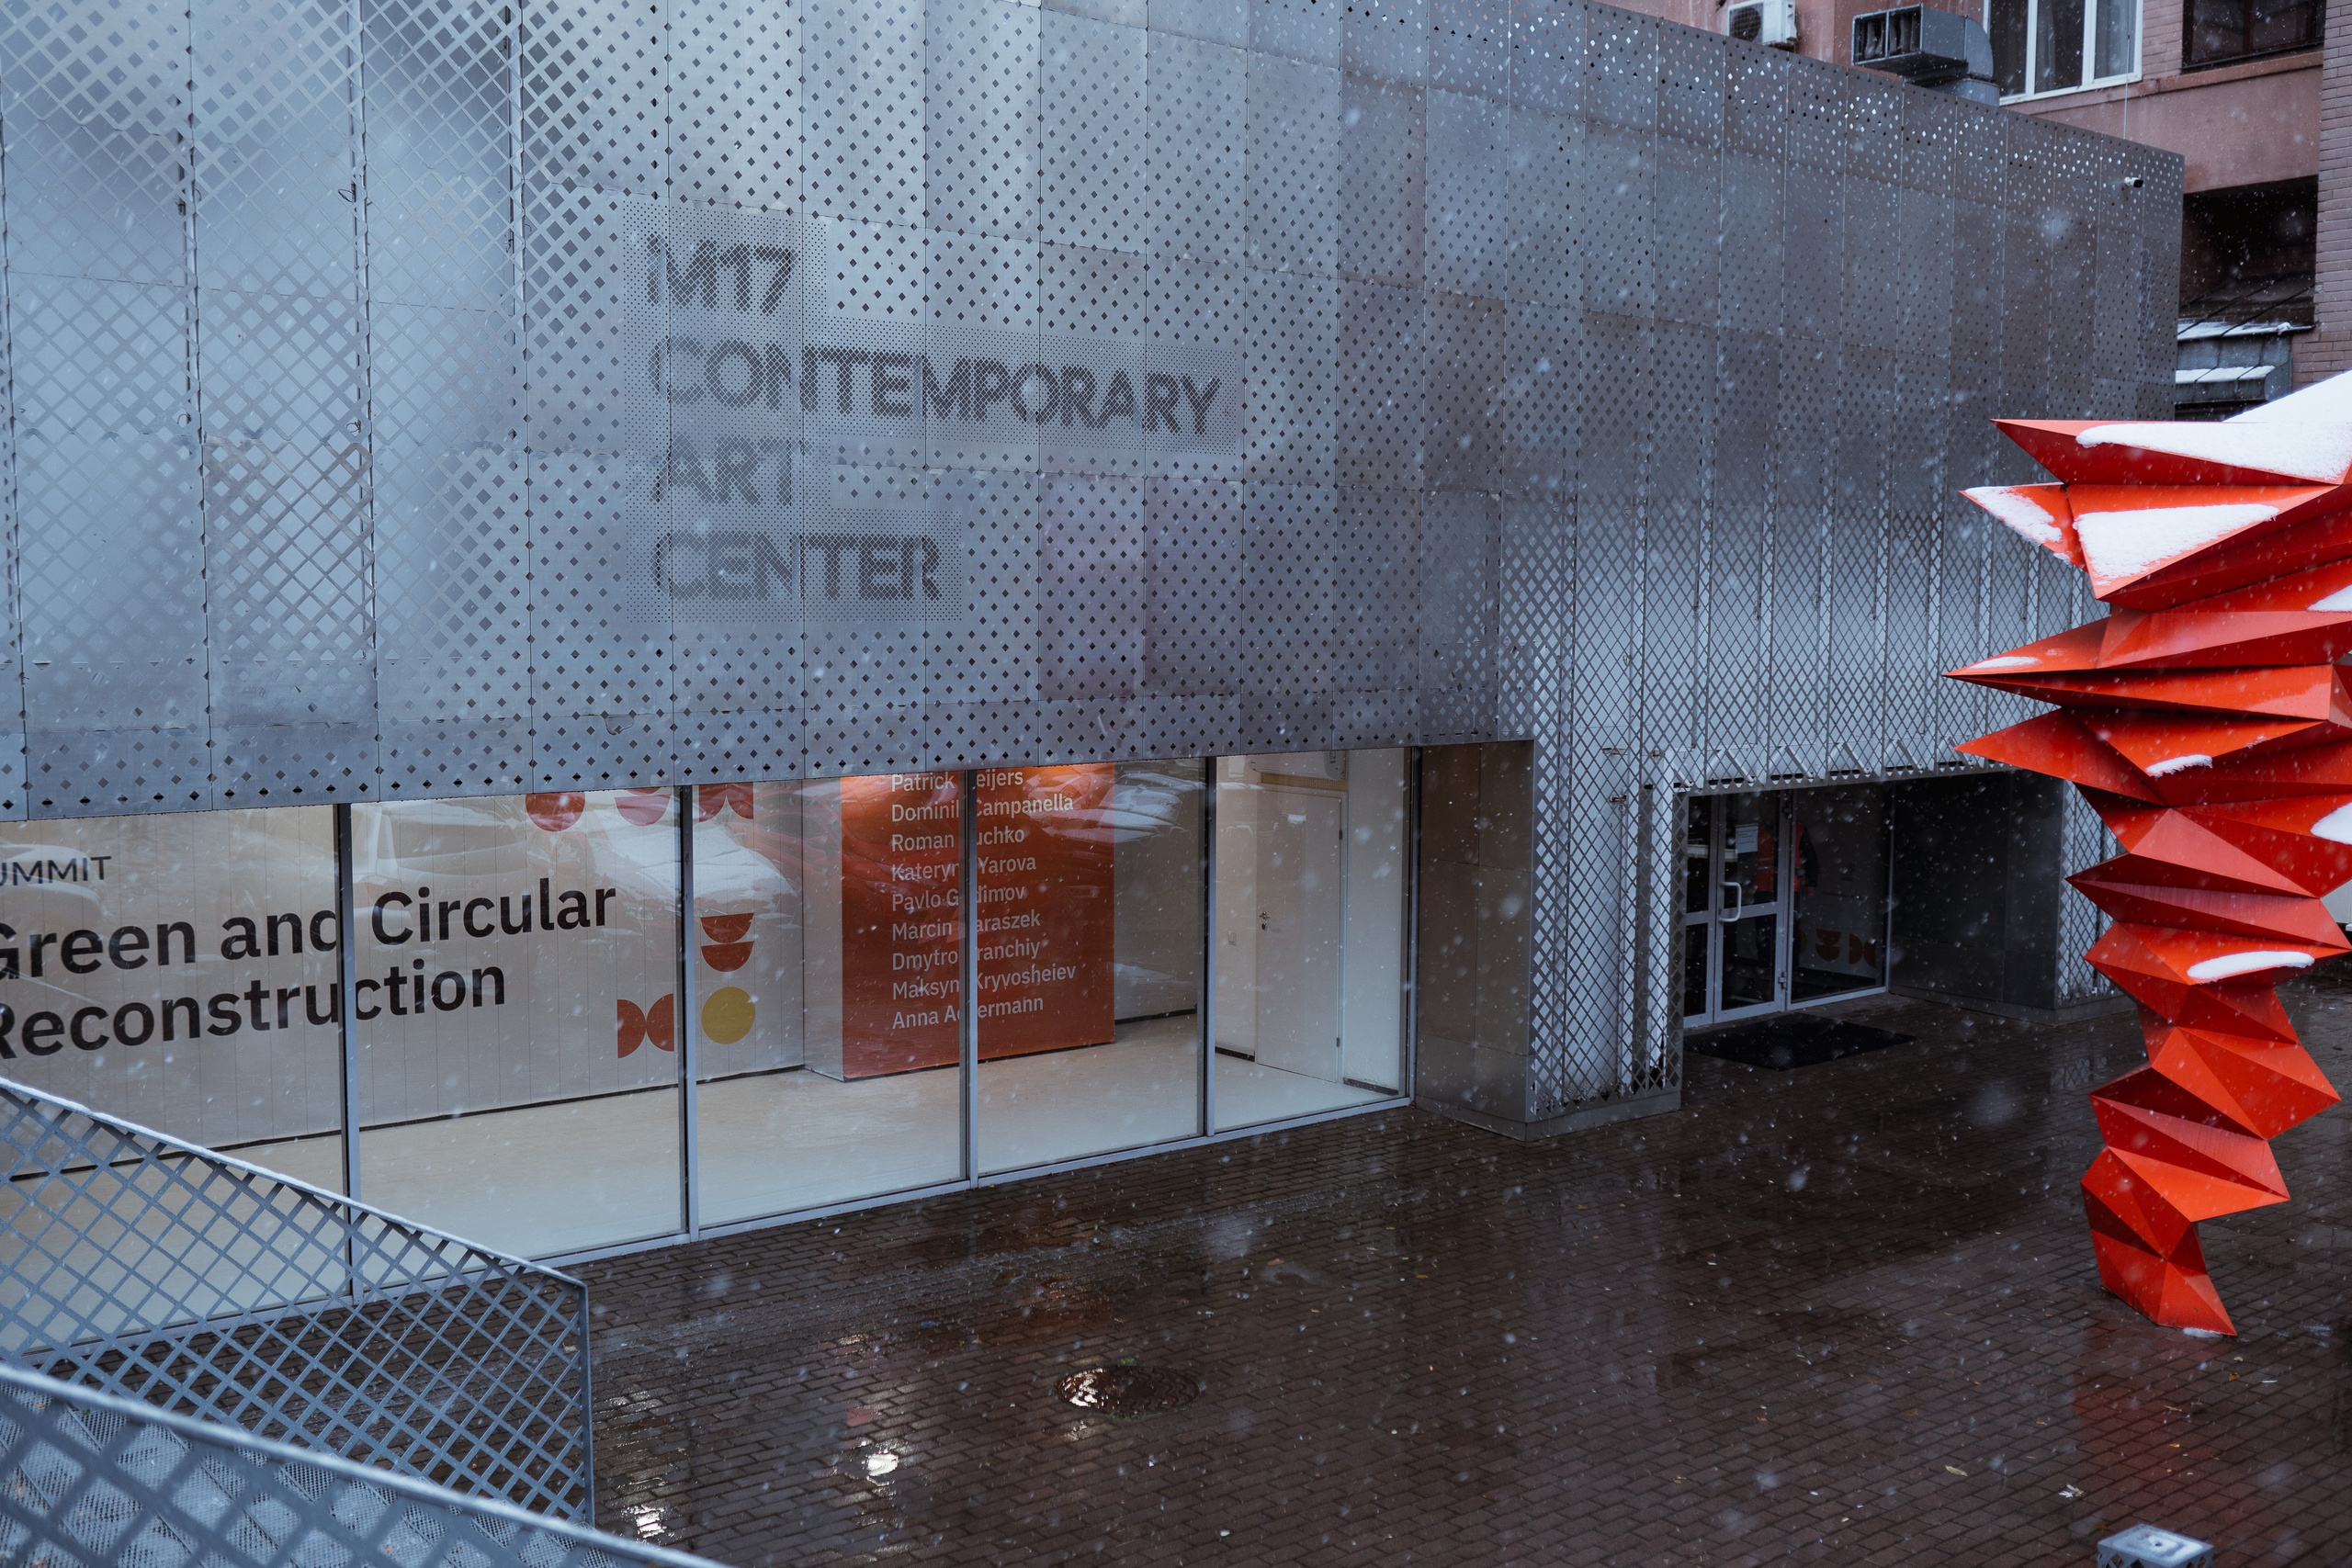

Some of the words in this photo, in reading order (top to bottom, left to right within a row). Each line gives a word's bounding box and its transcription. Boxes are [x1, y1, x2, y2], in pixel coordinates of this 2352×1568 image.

[646, 231, 798, 316] M17
[649, 335, 1221, 435] CONTEMPORARY
[649, 432, 814, 506] ART
[649, 529, 942, 602] CENTER
[891, 772, 956, 792] Patrick
[976, 768, 1023, 791] eijers
[891, 833, 955, 852] Roman
[891, 863, 959, 883] Kateryn
[978, 856, 1036, 874] Yarova
[371, 877, 616, 946] Circular
[892, 890, 942, 912] Pavlo
[946, 885, 1026, 907] Gimov
[892, 919, 953, 941] Marcin
[977, 908, 1041, 932] araszek
[892, 948, 958, 972] Dmytro
[977, 937, 1041, 961] ranchiy
[892, 1010, 939, 1030] Anna
[944, 996, 1044, 1022] Aermann
